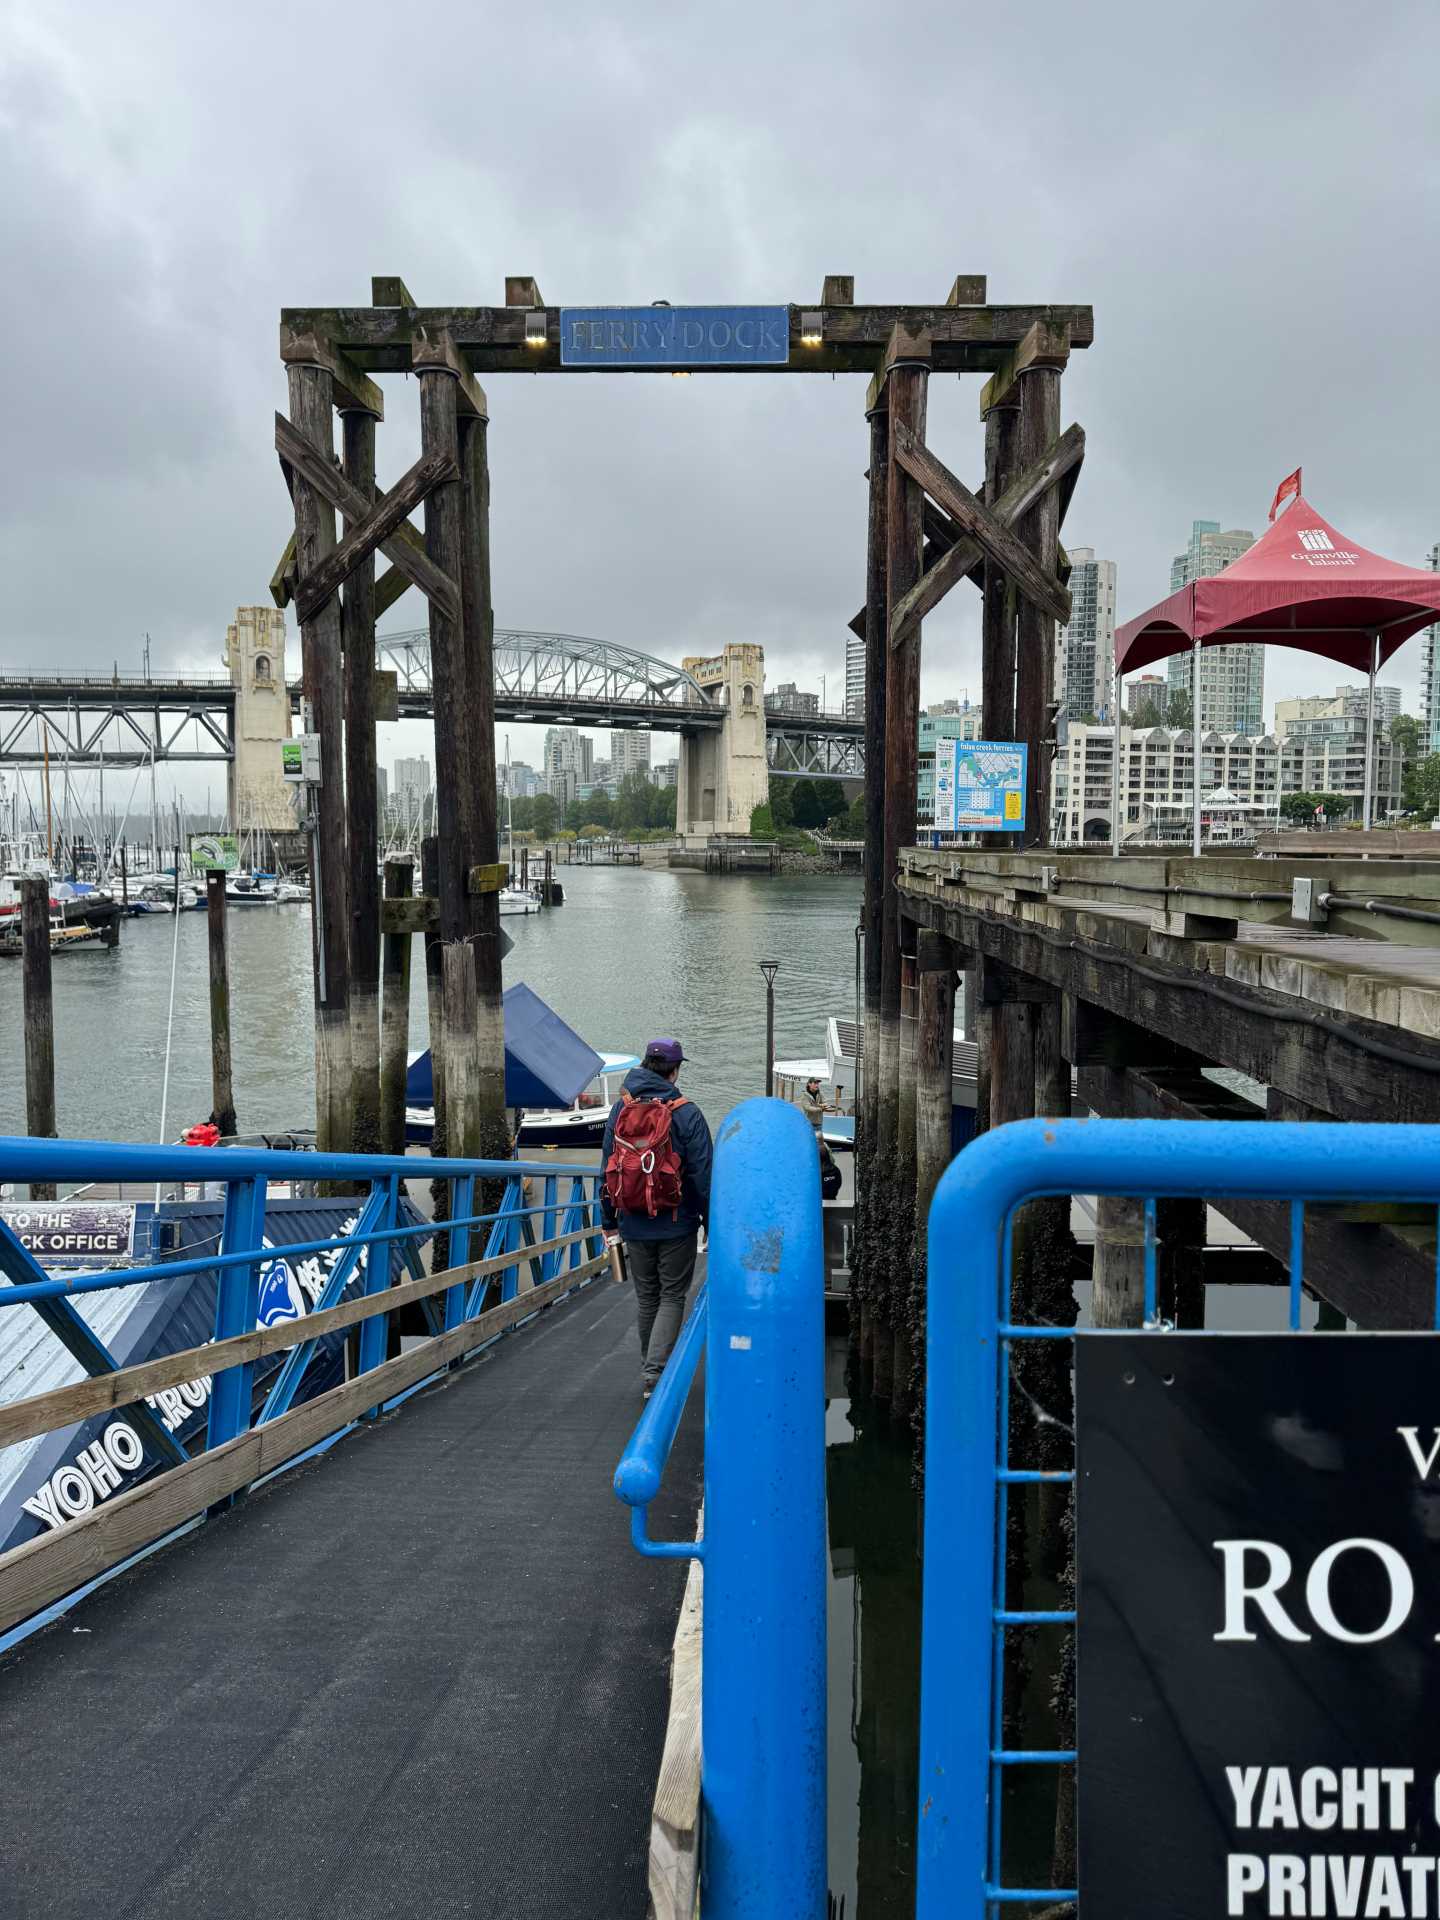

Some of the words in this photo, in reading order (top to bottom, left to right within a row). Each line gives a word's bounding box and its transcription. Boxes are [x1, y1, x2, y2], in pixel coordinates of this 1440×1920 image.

[570, 321, 672, 349] FERRY
[683, 320, 780, 349] DOCK
[1291, 551, 1360, 560] Granville
[1308, 559, 1355, 567] Island
[6, 1213, 31, 1228] TO
[36, 1213, 72, 1228] THE
[20, 1235, 45, 1249] CK
[50, 1235, 118, 1249] OFFICE
[1396, 1426, 1440, 1480] V
[21, 1421, 144, 1528] YOHO
[1212, 1538, 1440, 1644] RO
[1225, 1766, 1414, 1831] YACHT
[1227, 1853, 1440, 1918] PRIVAT
